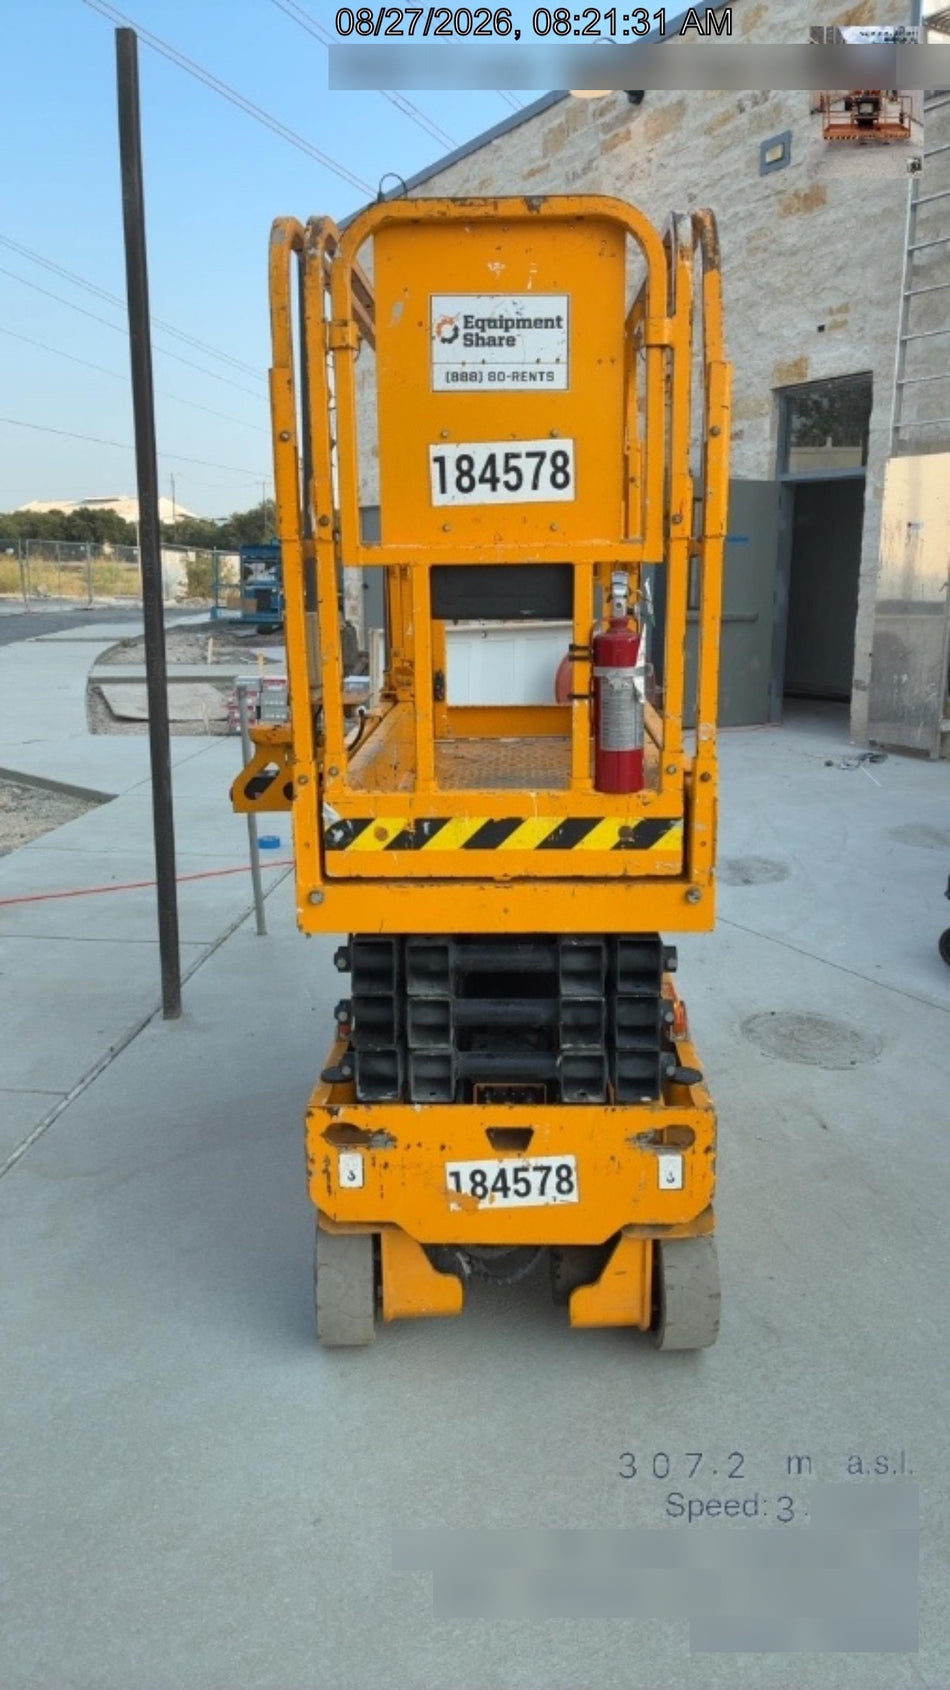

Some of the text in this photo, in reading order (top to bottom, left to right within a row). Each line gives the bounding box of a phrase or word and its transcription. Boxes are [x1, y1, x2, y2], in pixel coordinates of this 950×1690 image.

[463, 315, 563, 332] Equipment
[463, 332, 517, 348] Share
[488, 371, 555, 382] 80-RENTS
[432, 450, 571, 495] 184578
[449, 1163, 575, 1201] 184578
